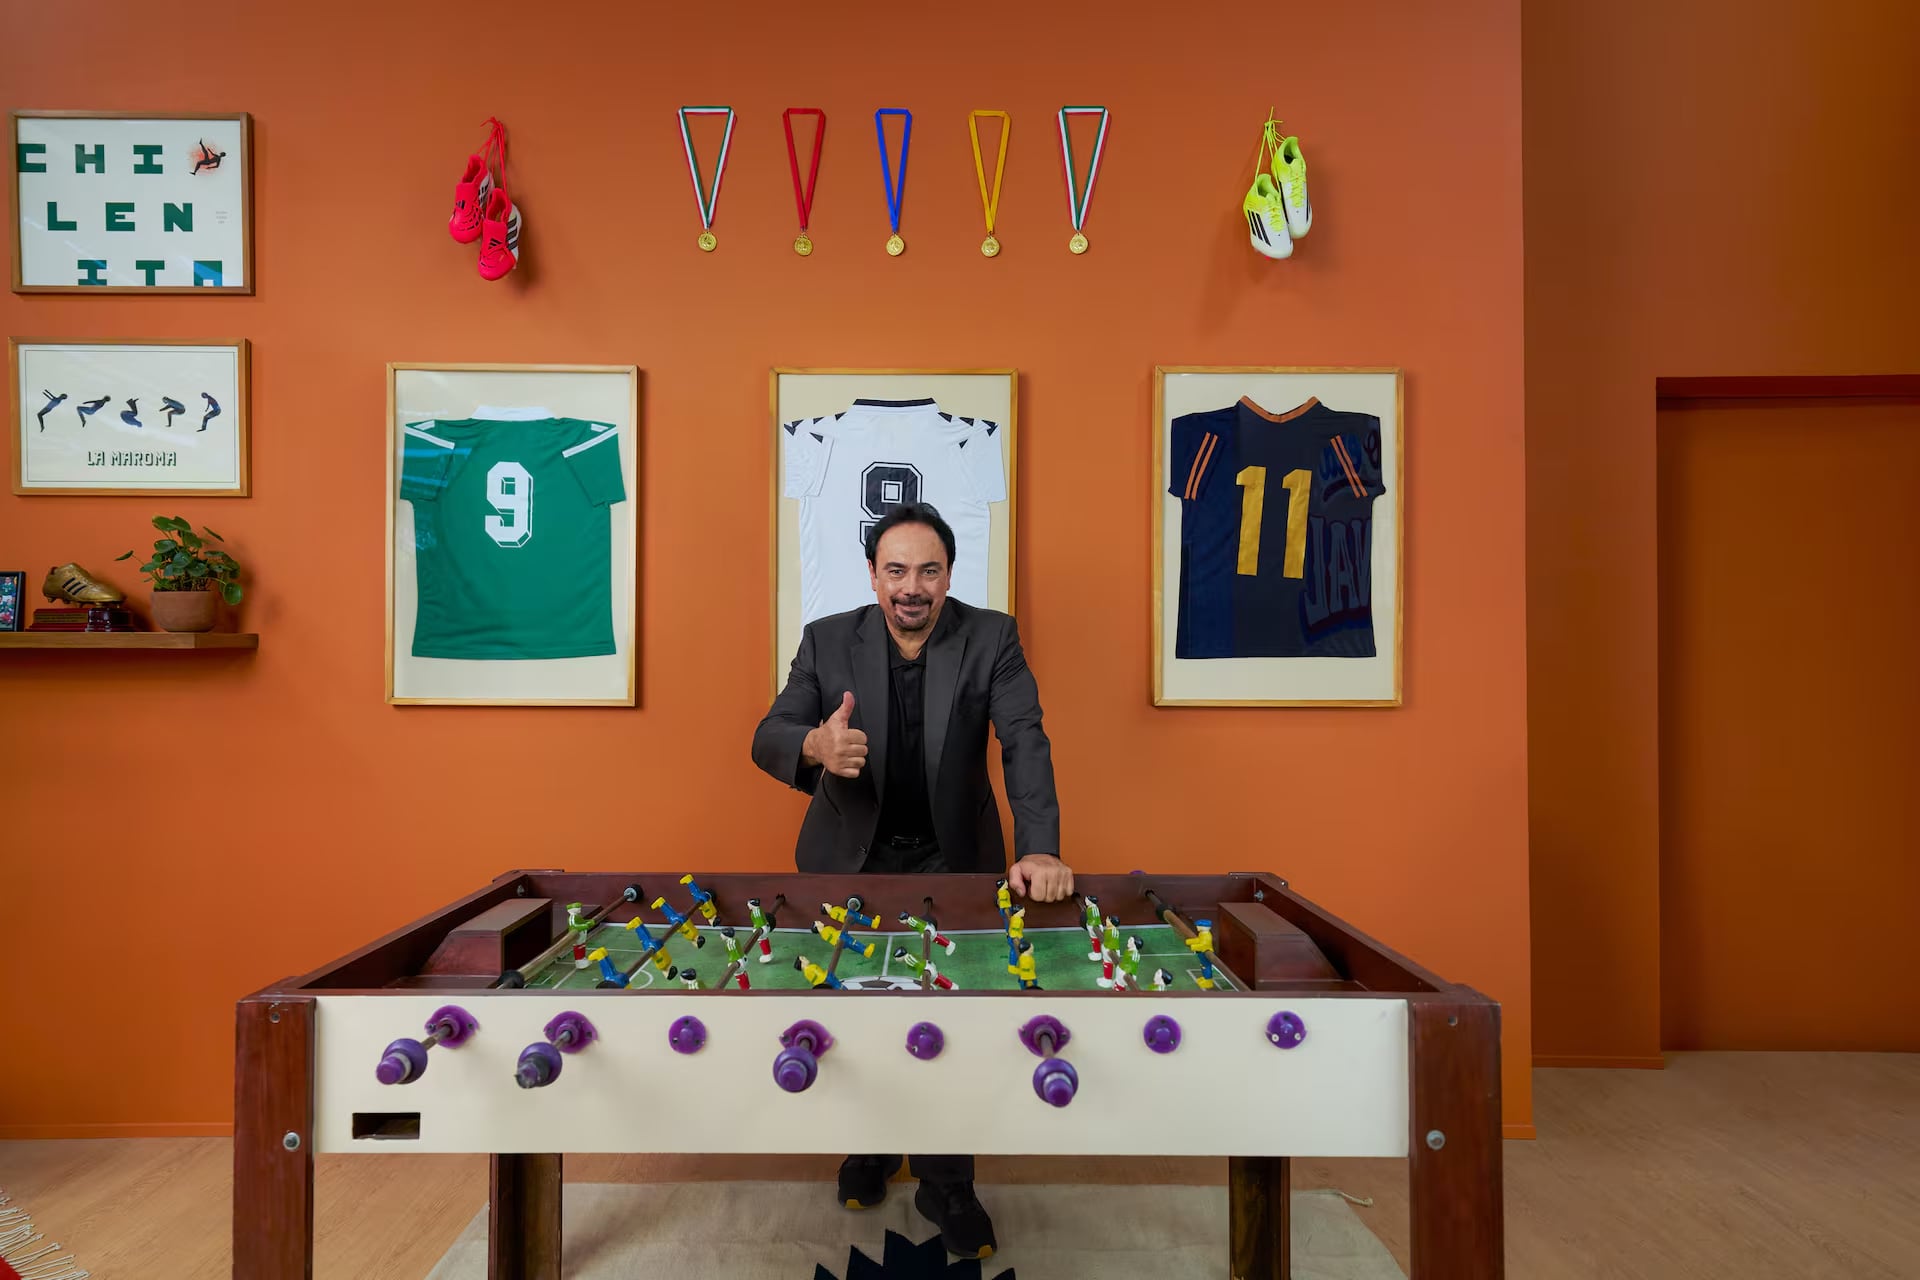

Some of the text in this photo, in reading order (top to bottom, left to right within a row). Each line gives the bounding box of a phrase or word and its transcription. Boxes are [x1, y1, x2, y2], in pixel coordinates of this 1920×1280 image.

[47, 201, 193, 231] LEN
[87, 451, 177, 467] LA MAROMA
[485, 461, 533, 548] 9
[1236, 465, 1312, 579] 11
